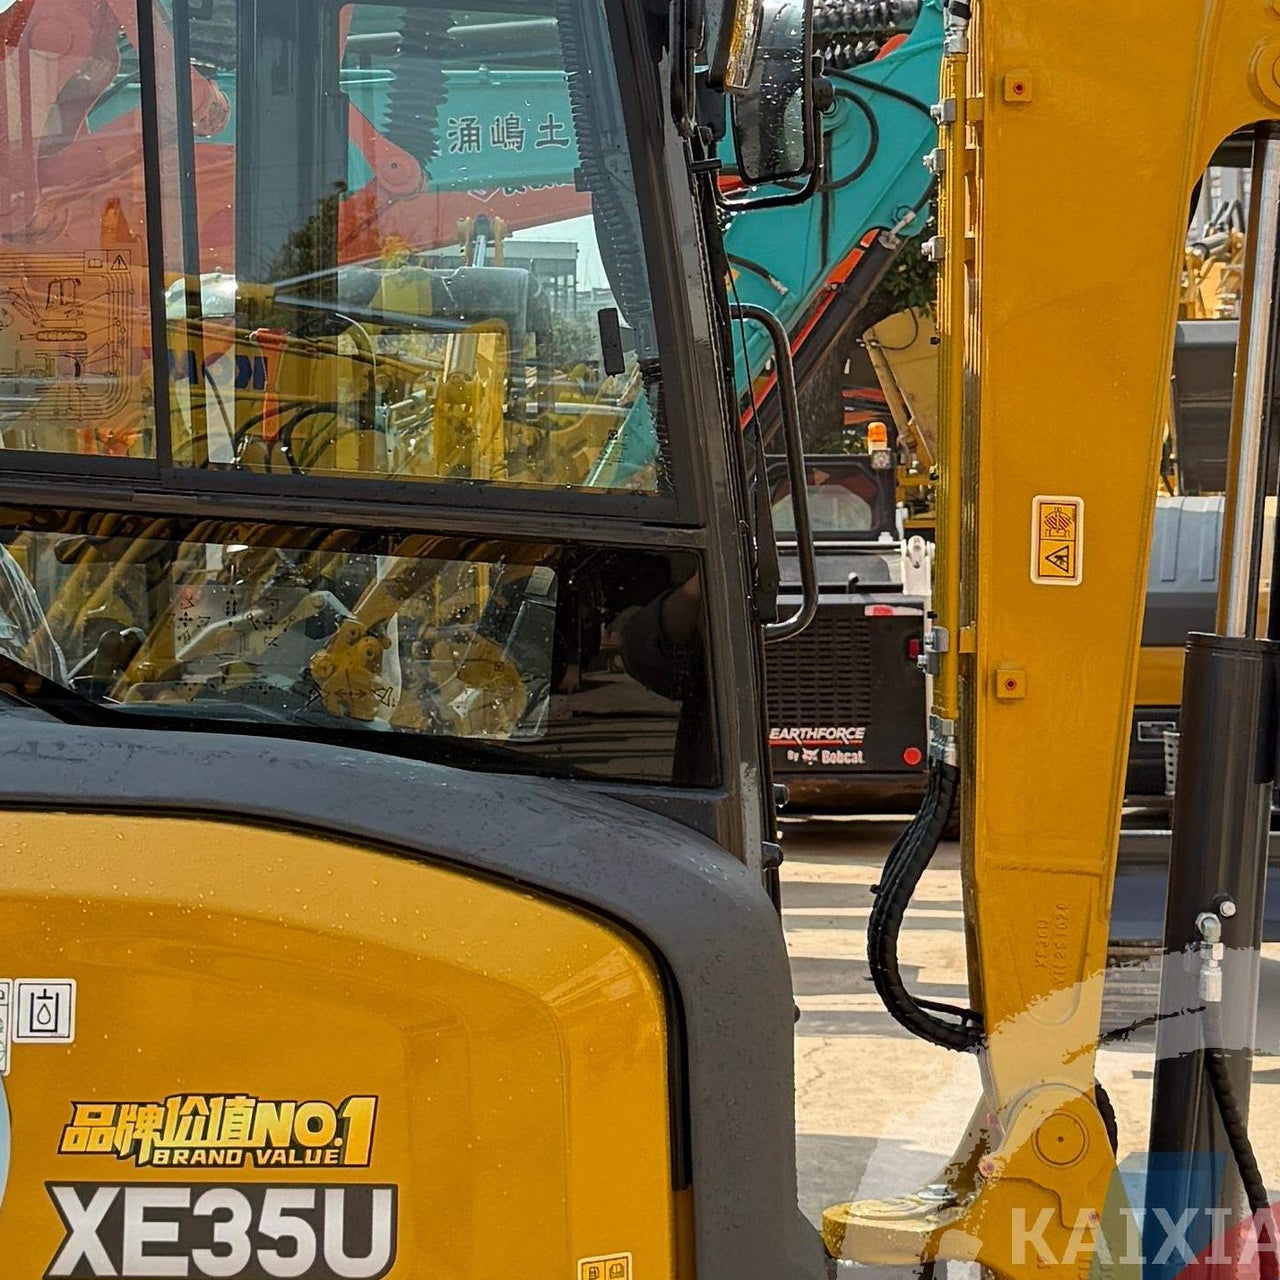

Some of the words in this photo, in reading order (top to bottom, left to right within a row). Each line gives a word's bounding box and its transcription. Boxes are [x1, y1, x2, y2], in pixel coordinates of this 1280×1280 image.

[770, 727, 866, 745] EARTHFORCE
[787, 750, 799, 762] By
[822, 750, 864, 764] Bobcat
[152, 1149, 242, 1165] BRAND
[257, 1149, 340, 1164] VALUE
[49, 1186, 393, 1278] XE35U
